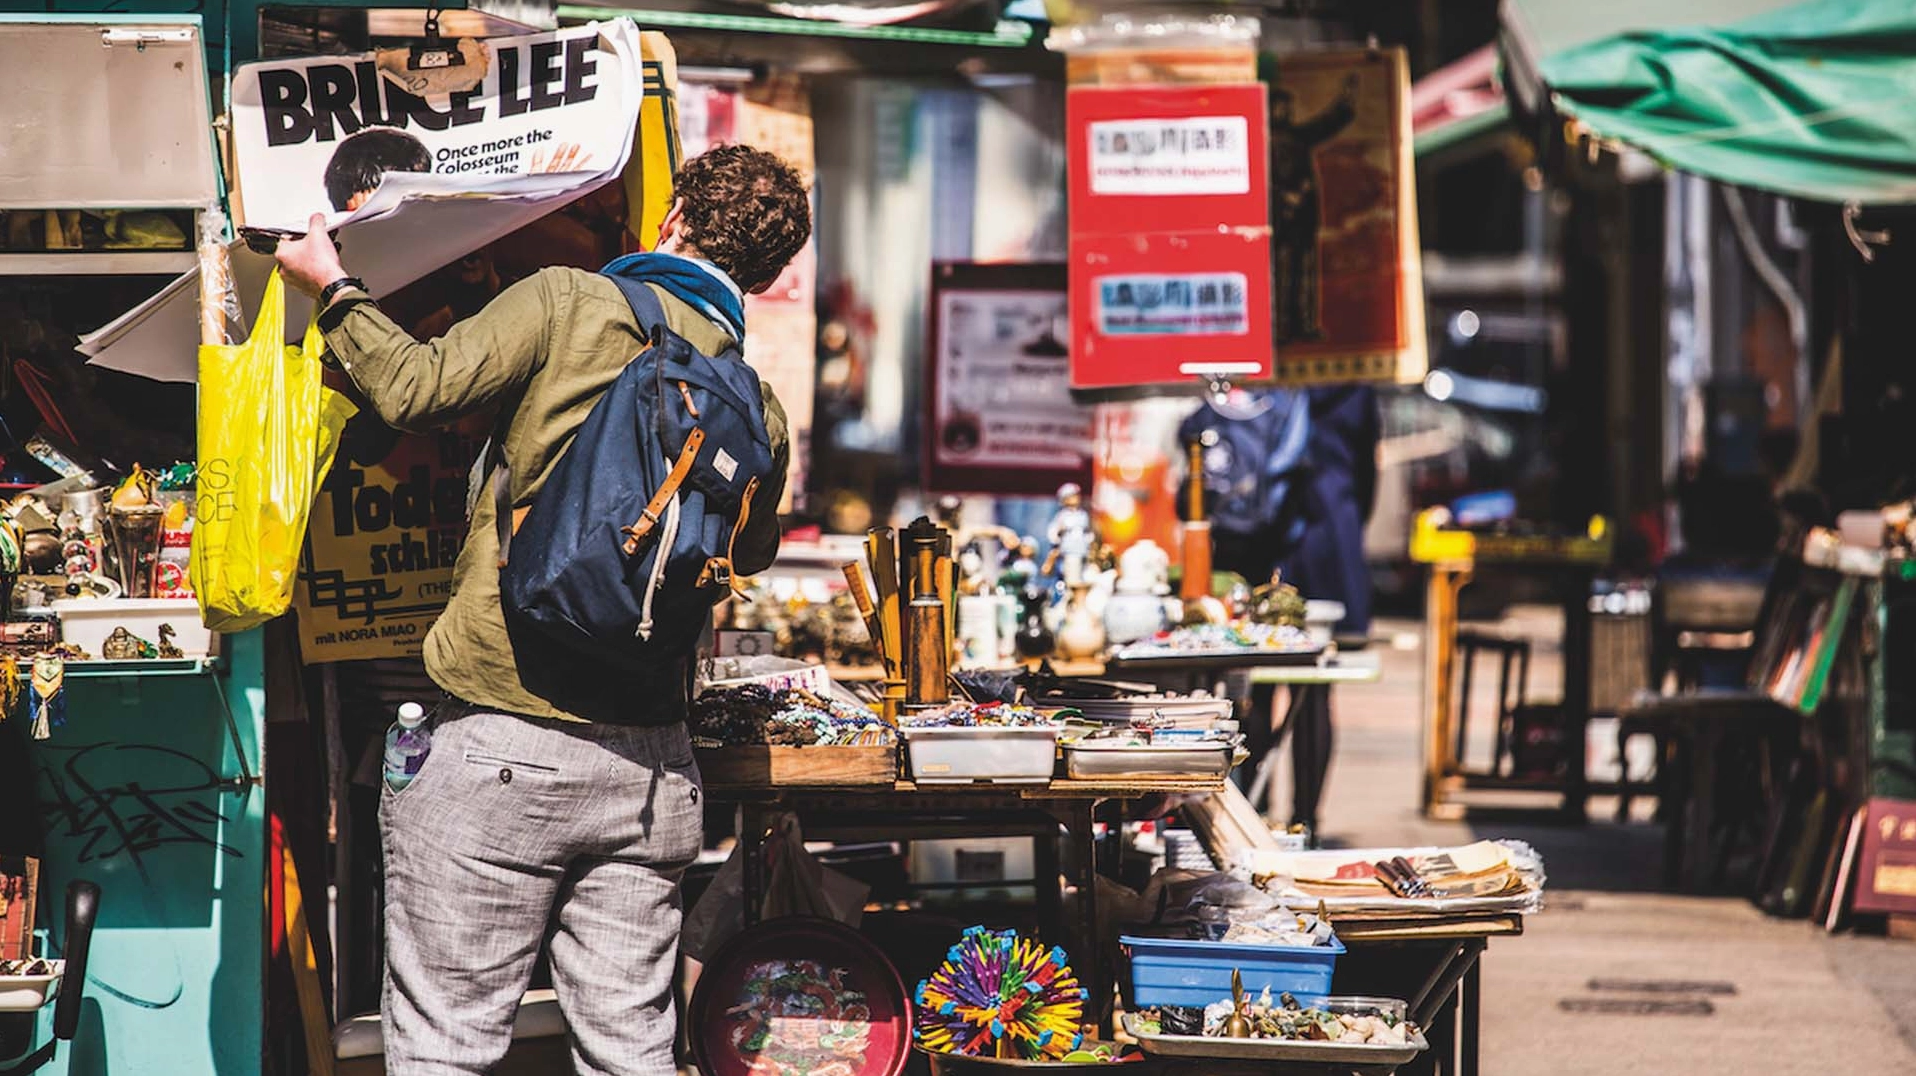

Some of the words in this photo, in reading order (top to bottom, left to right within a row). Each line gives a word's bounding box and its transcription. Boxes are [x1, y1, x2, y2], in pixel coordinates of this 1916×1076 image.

[497, 32, 599, 118] LEE
[436, 145, 479, 162] Once
[481, 135, 524, 154] more
[527, 129, 553, 144] the
[436, 151, 519, 174] Colosseum
[315, 632, 337, 645] mit
[339, 627, 378, 642] NORA
[381, 623, 416, 637] MIAO
